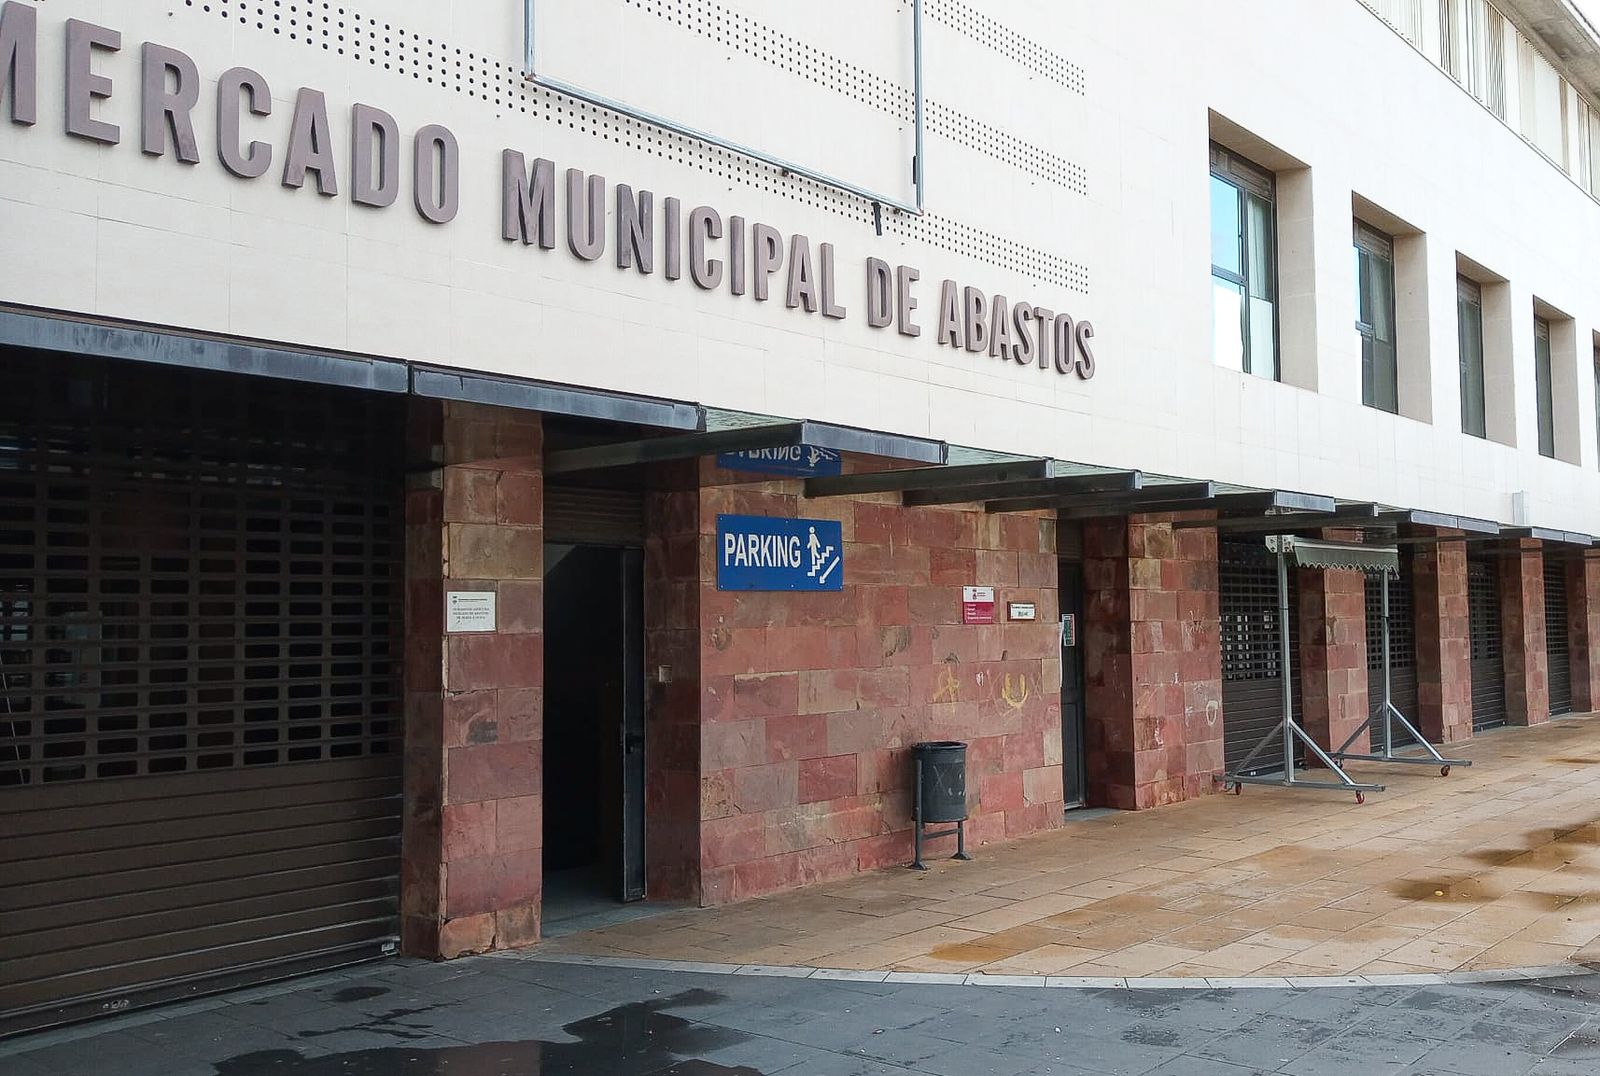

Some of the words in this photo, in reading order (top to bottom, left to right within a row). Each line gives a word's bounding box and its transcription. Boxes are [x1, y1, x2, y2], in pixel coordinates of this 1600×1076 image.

[501, 148, 847, 320] MUNICIPAL
[866, 256, 921, 337] DE
[937, 279, 1095, 380] ABASTOS
[724, 532, 801, 568] PARKING
